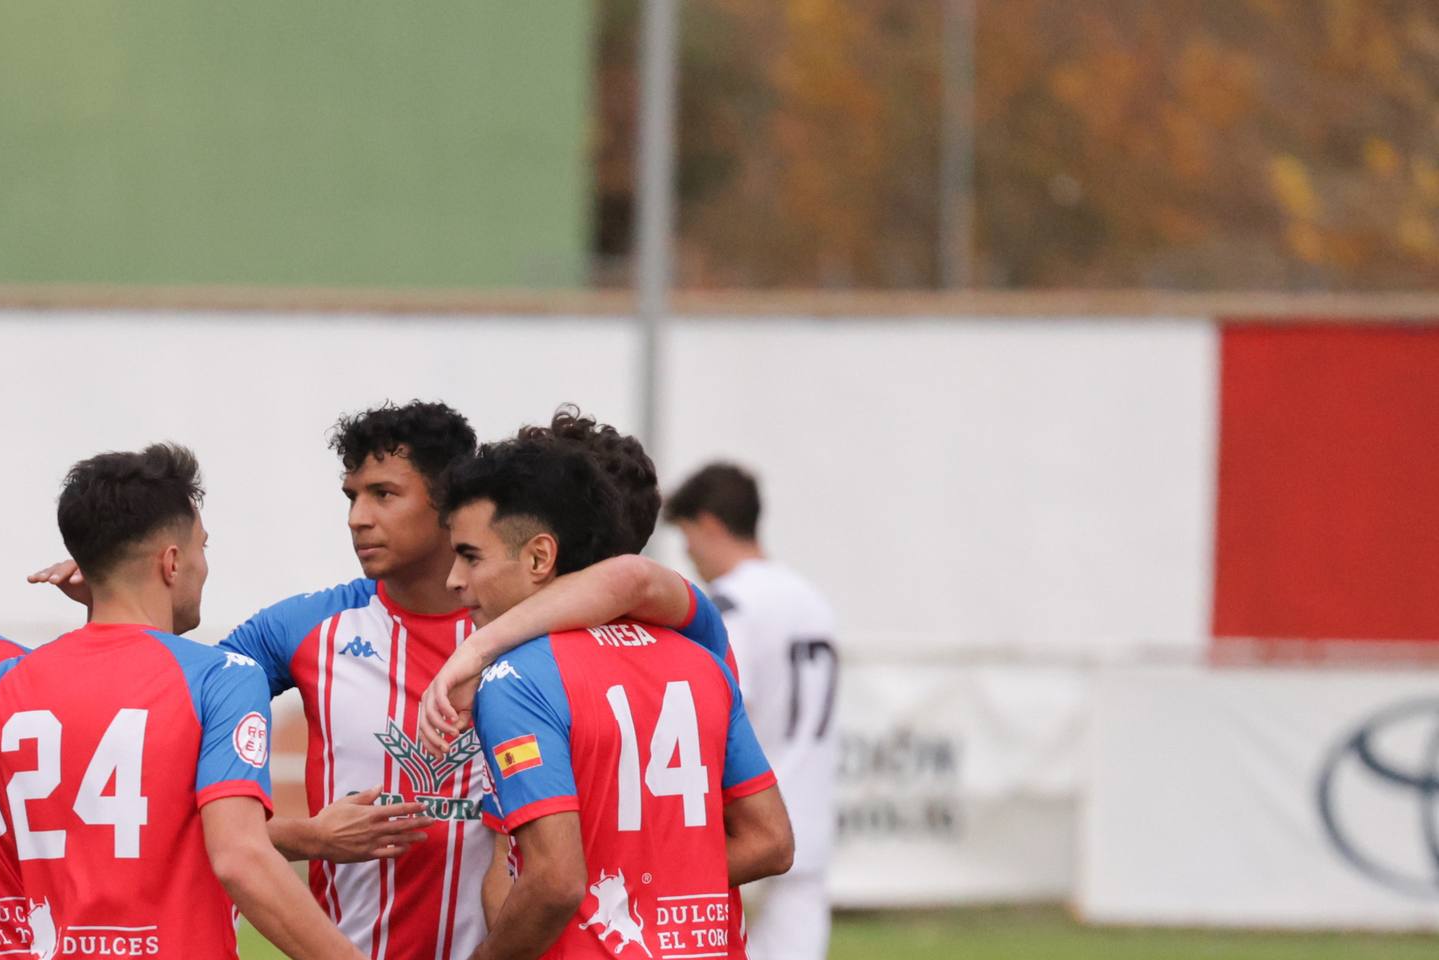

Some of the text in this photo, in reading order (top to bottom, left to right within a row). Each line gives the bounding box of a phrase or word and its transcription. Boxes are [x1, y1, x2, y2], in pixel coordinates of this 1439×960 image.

[785, 638, 839, 741] 17
[1, 708, 149, 861] 24
[606, 680, 709, 832] 14
[62, 936, 159, 955] DULCES
[657, 931, 686, 949] EL
